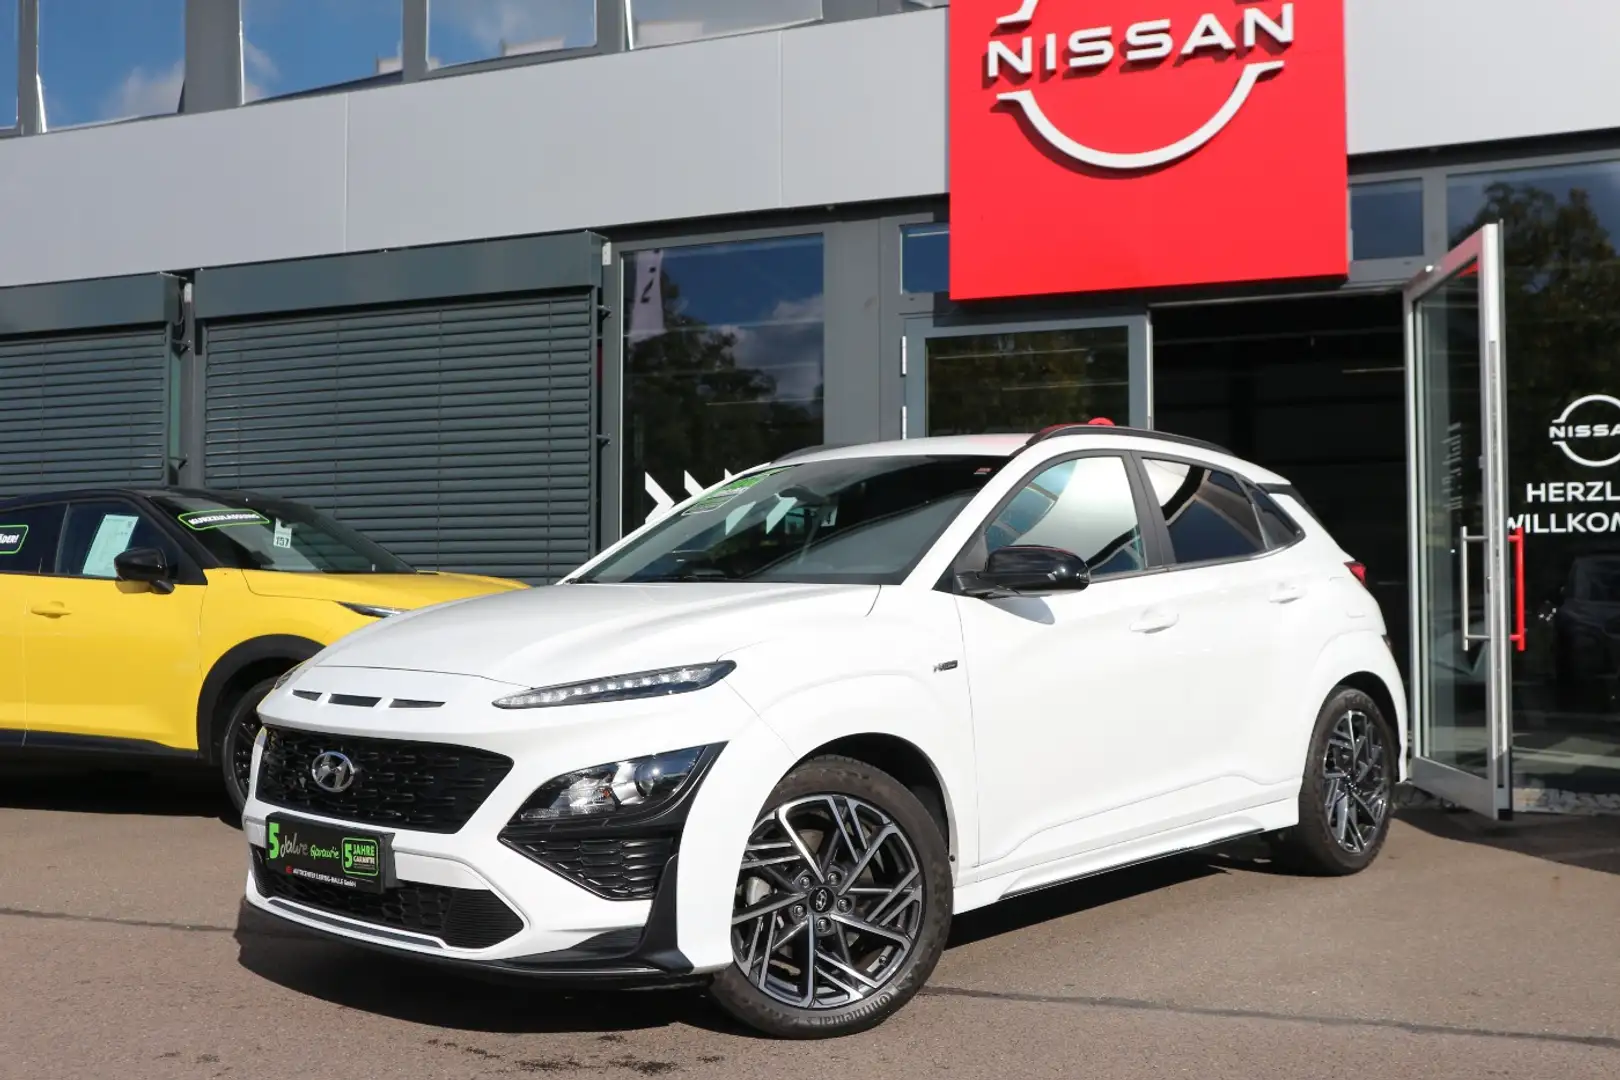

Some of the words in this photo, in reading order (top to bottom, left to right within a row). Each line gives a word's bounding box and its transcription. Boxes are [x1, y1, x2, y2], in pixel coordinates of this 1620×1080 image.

[987, 3, 1294, 78] NISSAN
[1526, 481, 1620, 503] HERZL
[268, 822, 280, 859] 5
[344, 843, 353, 868] 5
[353, 844, 375, 856] JAHRE
